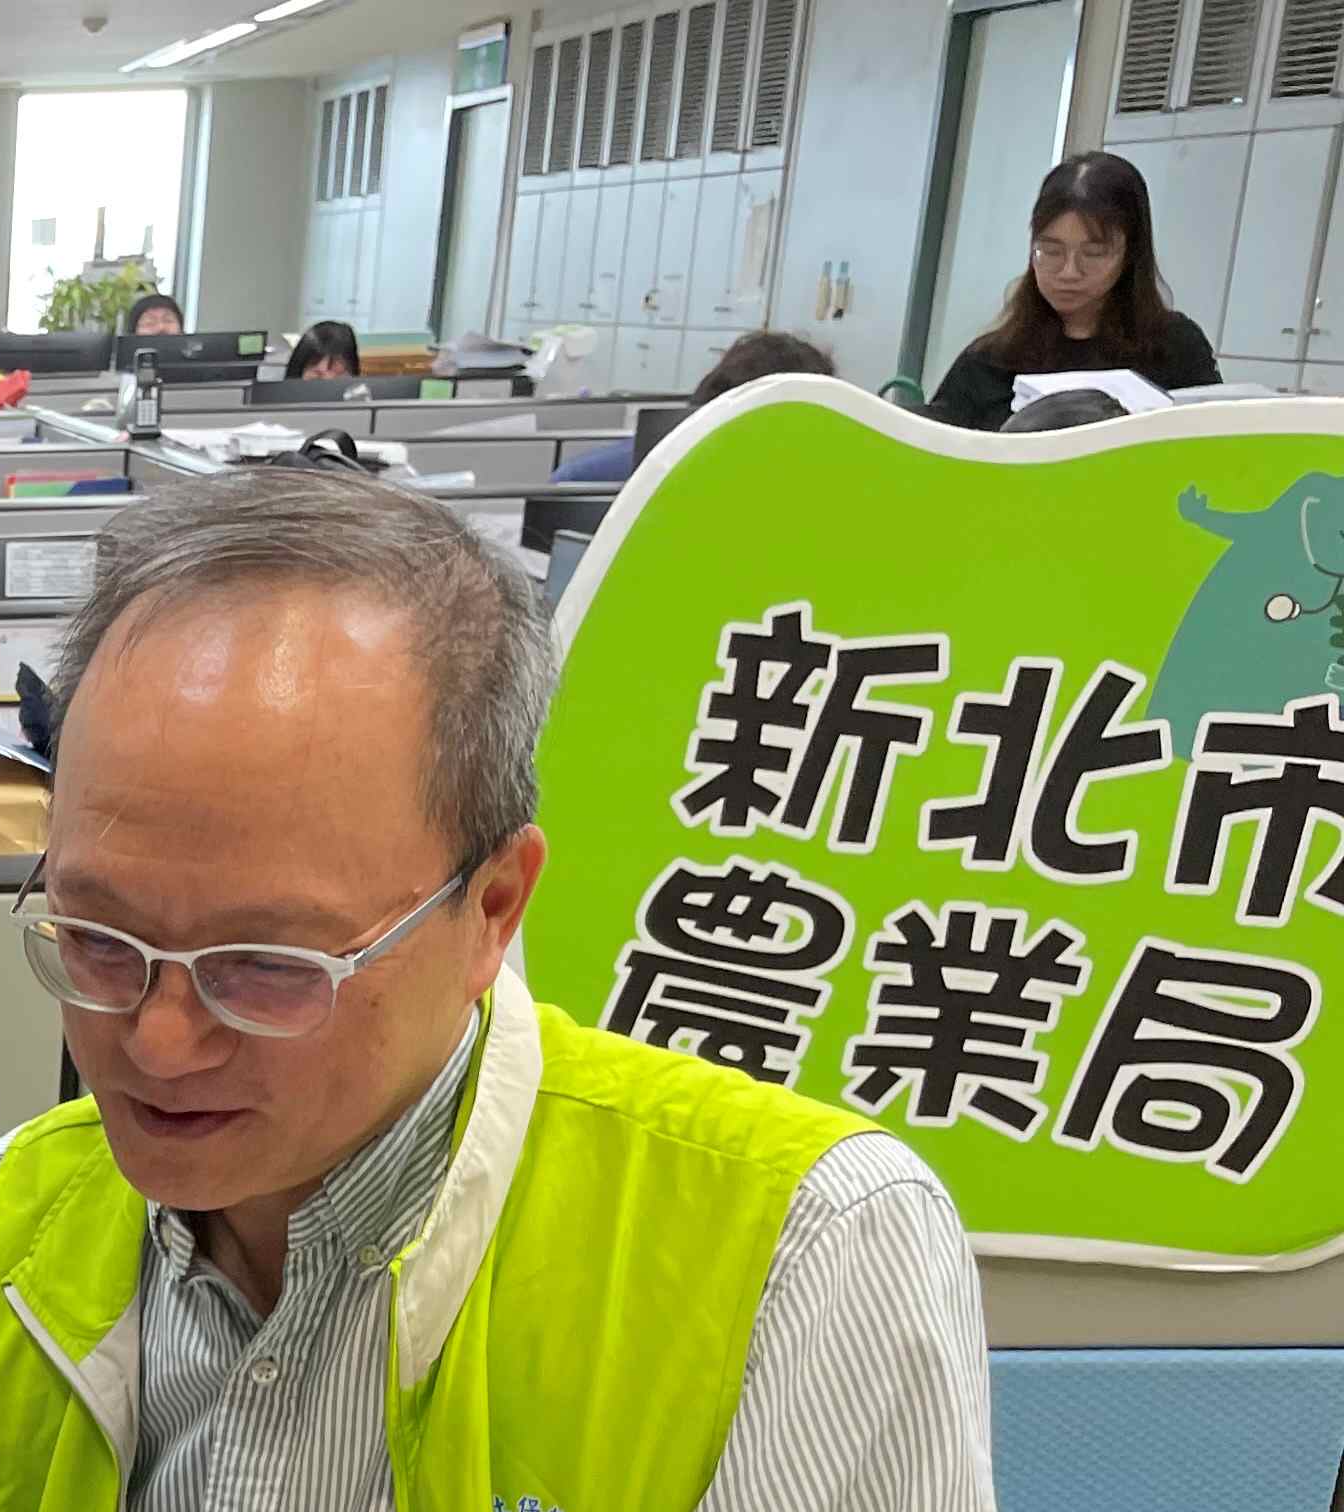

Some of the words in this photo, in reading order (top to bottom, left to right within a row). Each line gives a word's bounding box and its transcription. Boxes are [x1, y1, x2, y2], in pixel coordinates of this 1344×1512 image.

[679, 608, 1344, 919] 新北市
[605, 863, 1315, 1176] 農業局
